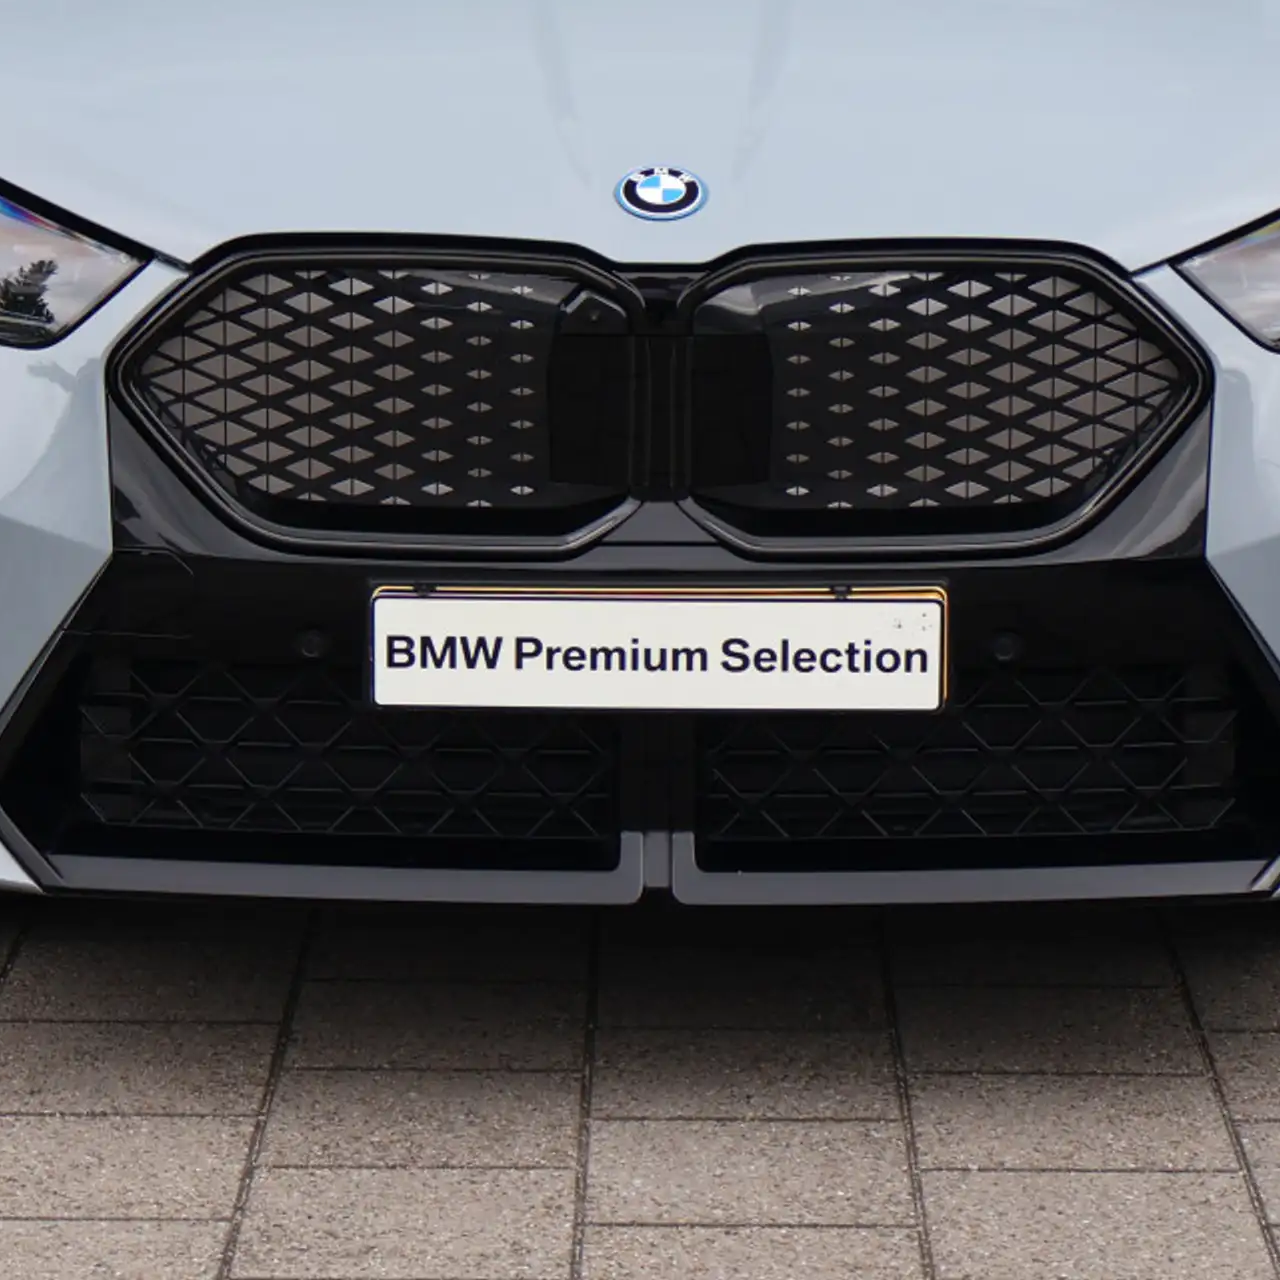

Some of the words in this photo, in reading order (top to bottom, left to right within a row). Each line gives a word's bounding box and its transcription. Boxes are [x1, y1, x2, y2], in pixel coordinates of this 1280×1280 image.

[386, 636, 503, 670] BMW
[514, 637, 708, 672] Premium
[721, 638, 928, 673] Selection
